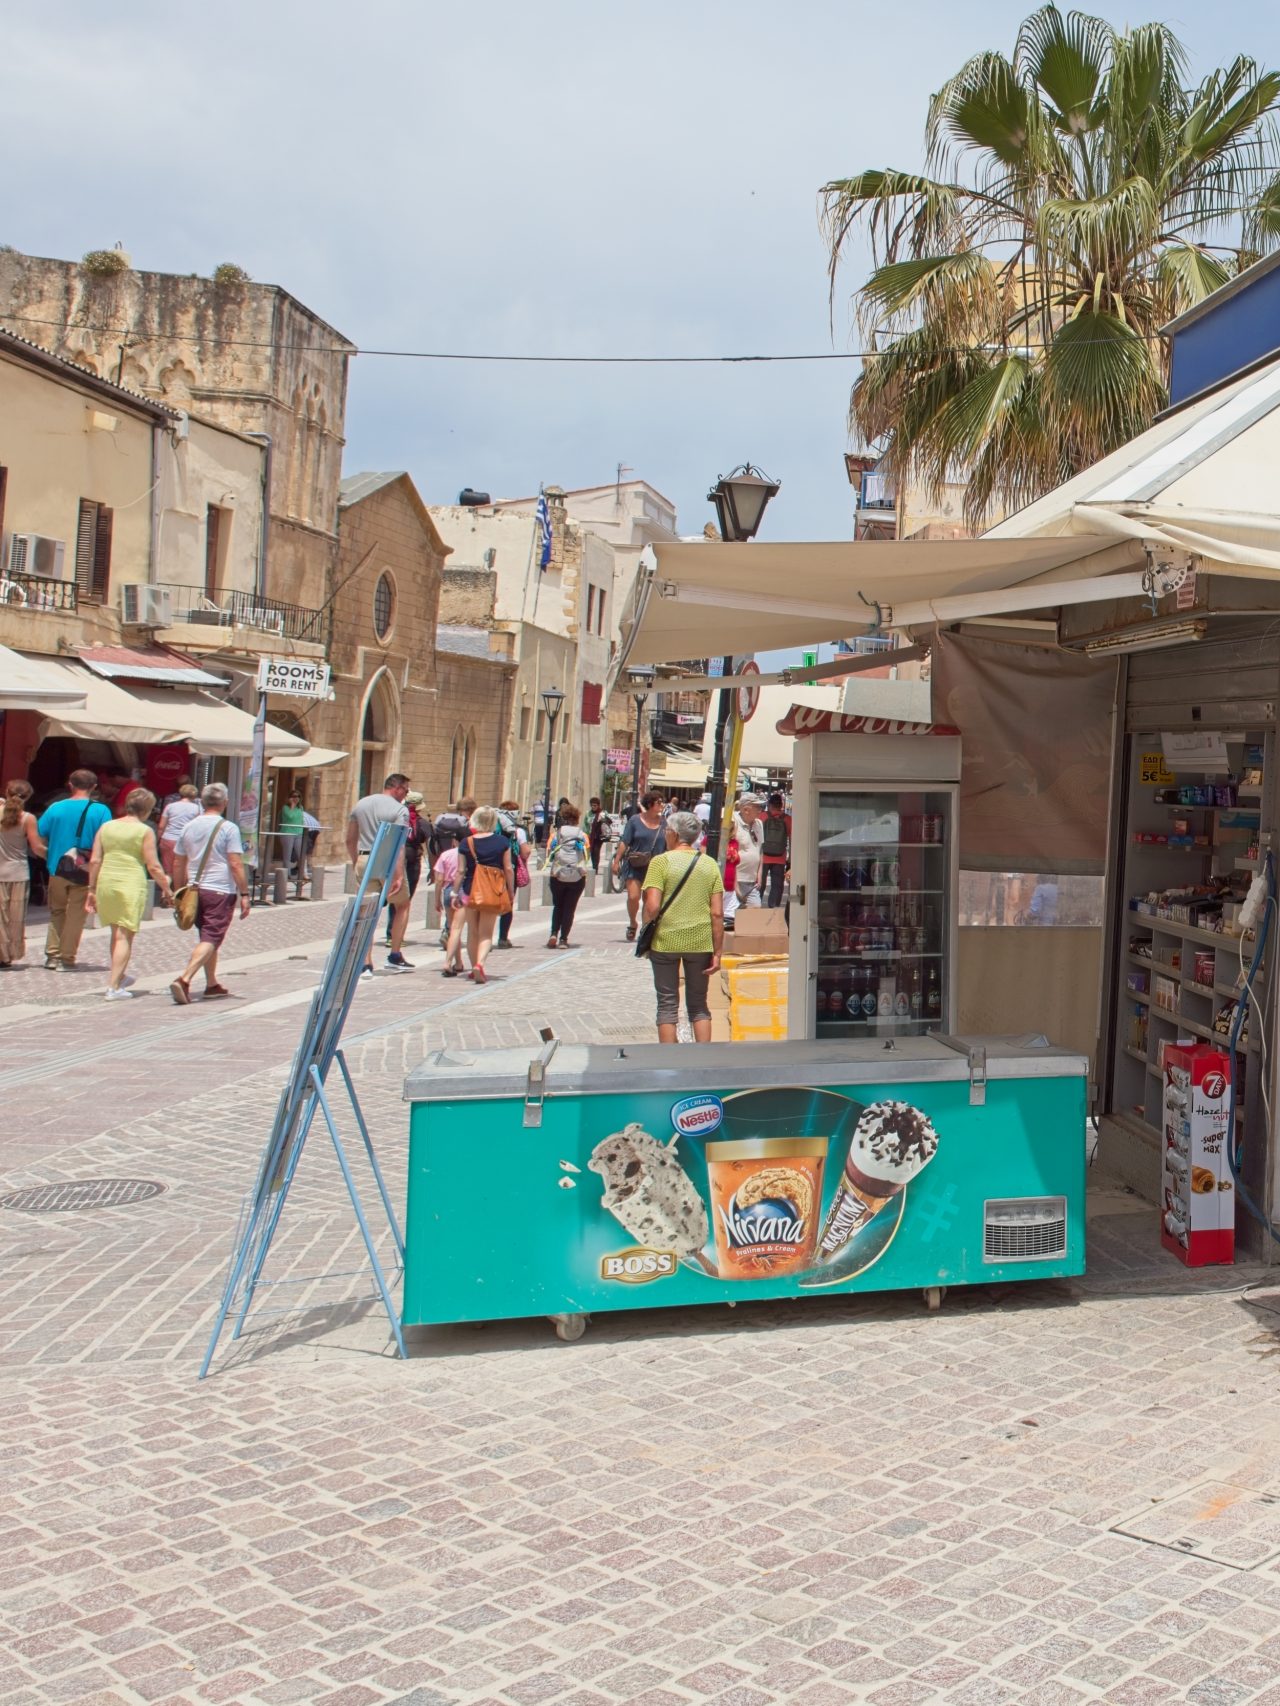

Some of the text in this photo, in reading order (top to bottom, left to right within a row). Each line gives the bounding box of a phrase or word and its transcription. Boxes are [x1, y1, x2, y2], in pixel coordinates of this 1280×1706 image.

[268, 664, 324, 680] ROOMS
[266, 677, 318, 691] FOR RENT
[1142, 771, 1159, 782] 5€
[1206, 1075, 1221, 1096] 7
[680, 1098, 712, 1111] ICE CREAM
[1196, 1105, 1223, 1116] Hazel
[1212, 1109, 1230, 1121] nut
[718, 1193, 805, 1249] Nirvana
[821, 1190, 866, 1252] MAGNUM
[775, 1245, 797, 1253] Cream
[607, 1254, 672, 1275] BOSS
